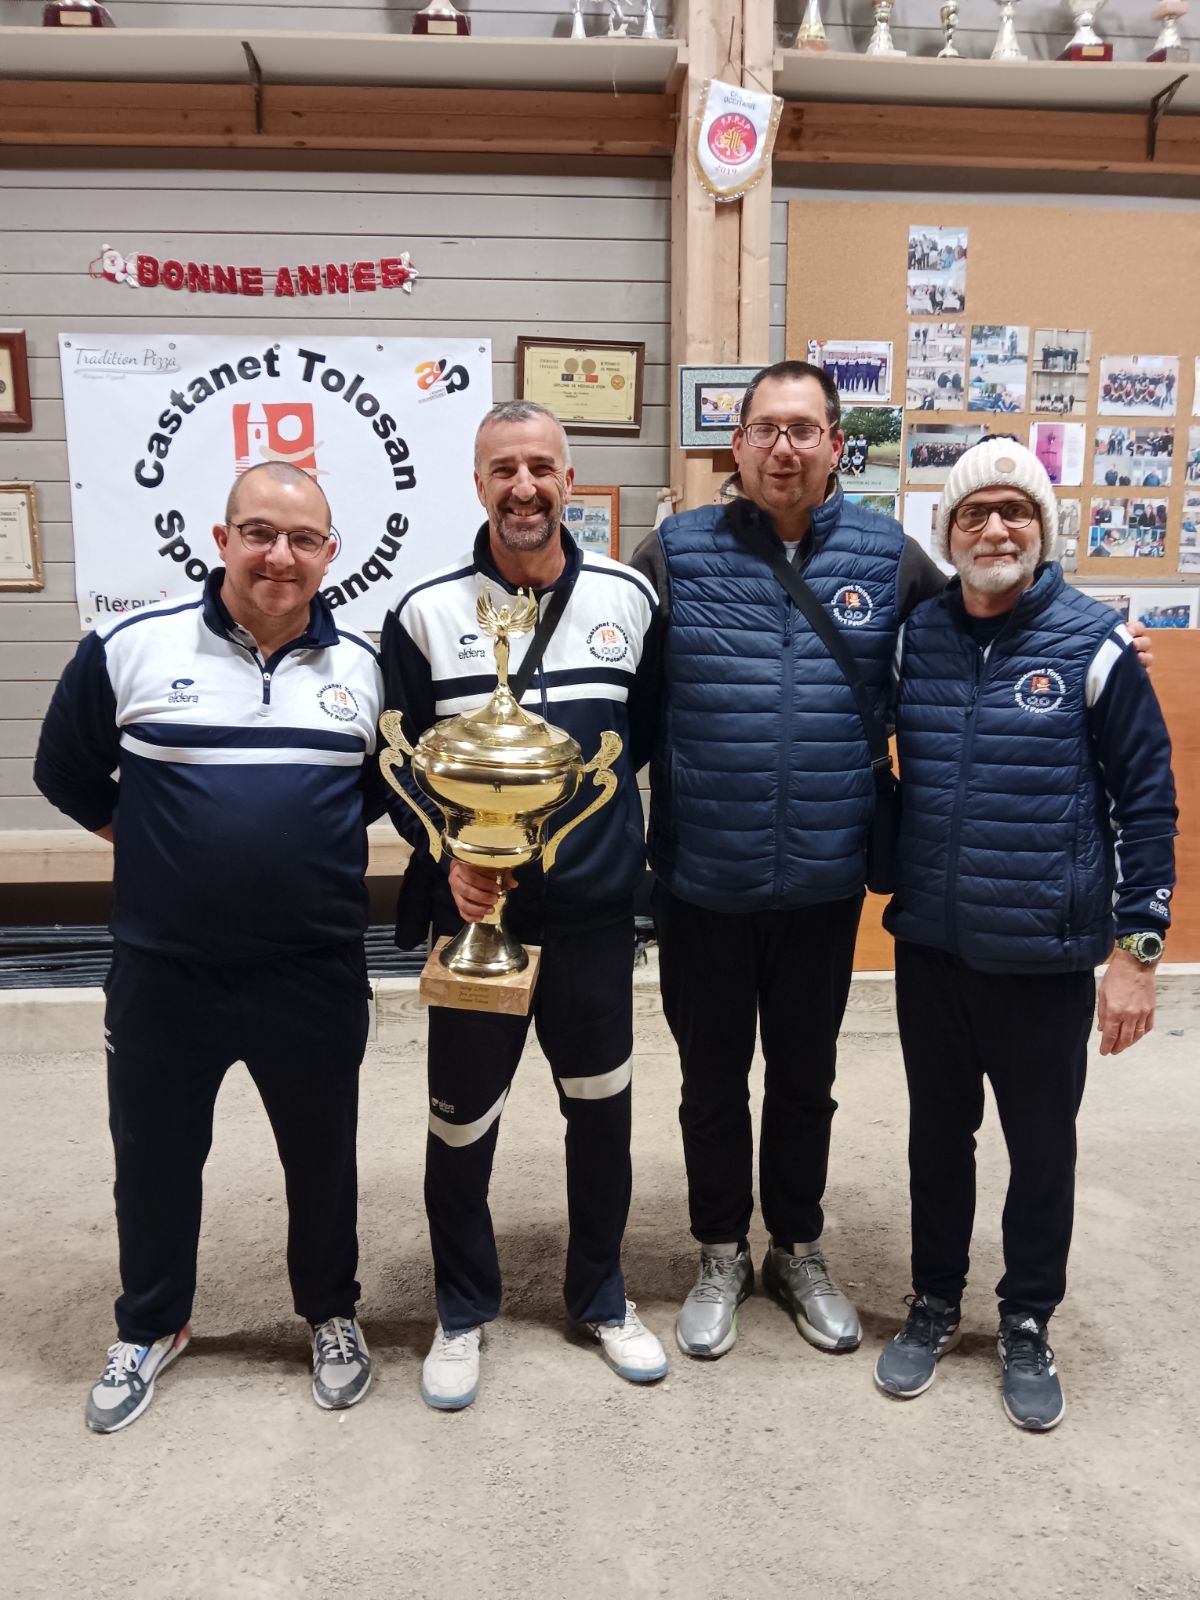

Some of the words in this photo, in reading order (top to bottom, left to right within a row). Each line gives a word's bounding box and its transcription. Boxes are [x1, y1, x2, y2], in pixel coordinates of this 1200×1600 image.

[137, 254, 264, 297] BONNE
[274, 257, 405, 297] ANNEE
[75, 348, 138, 366] Tradition
[143, 348, 177, 370] Pizza
[134, 347, 281, 489] Castanet
[297, 347, 417, 491] Tolosan
[154, 509, 209, 583] Spo
[320, 511, 410, 610] anque
[458, 648, 486, 660] eldera
[167, 690, 199, 703] eldera
